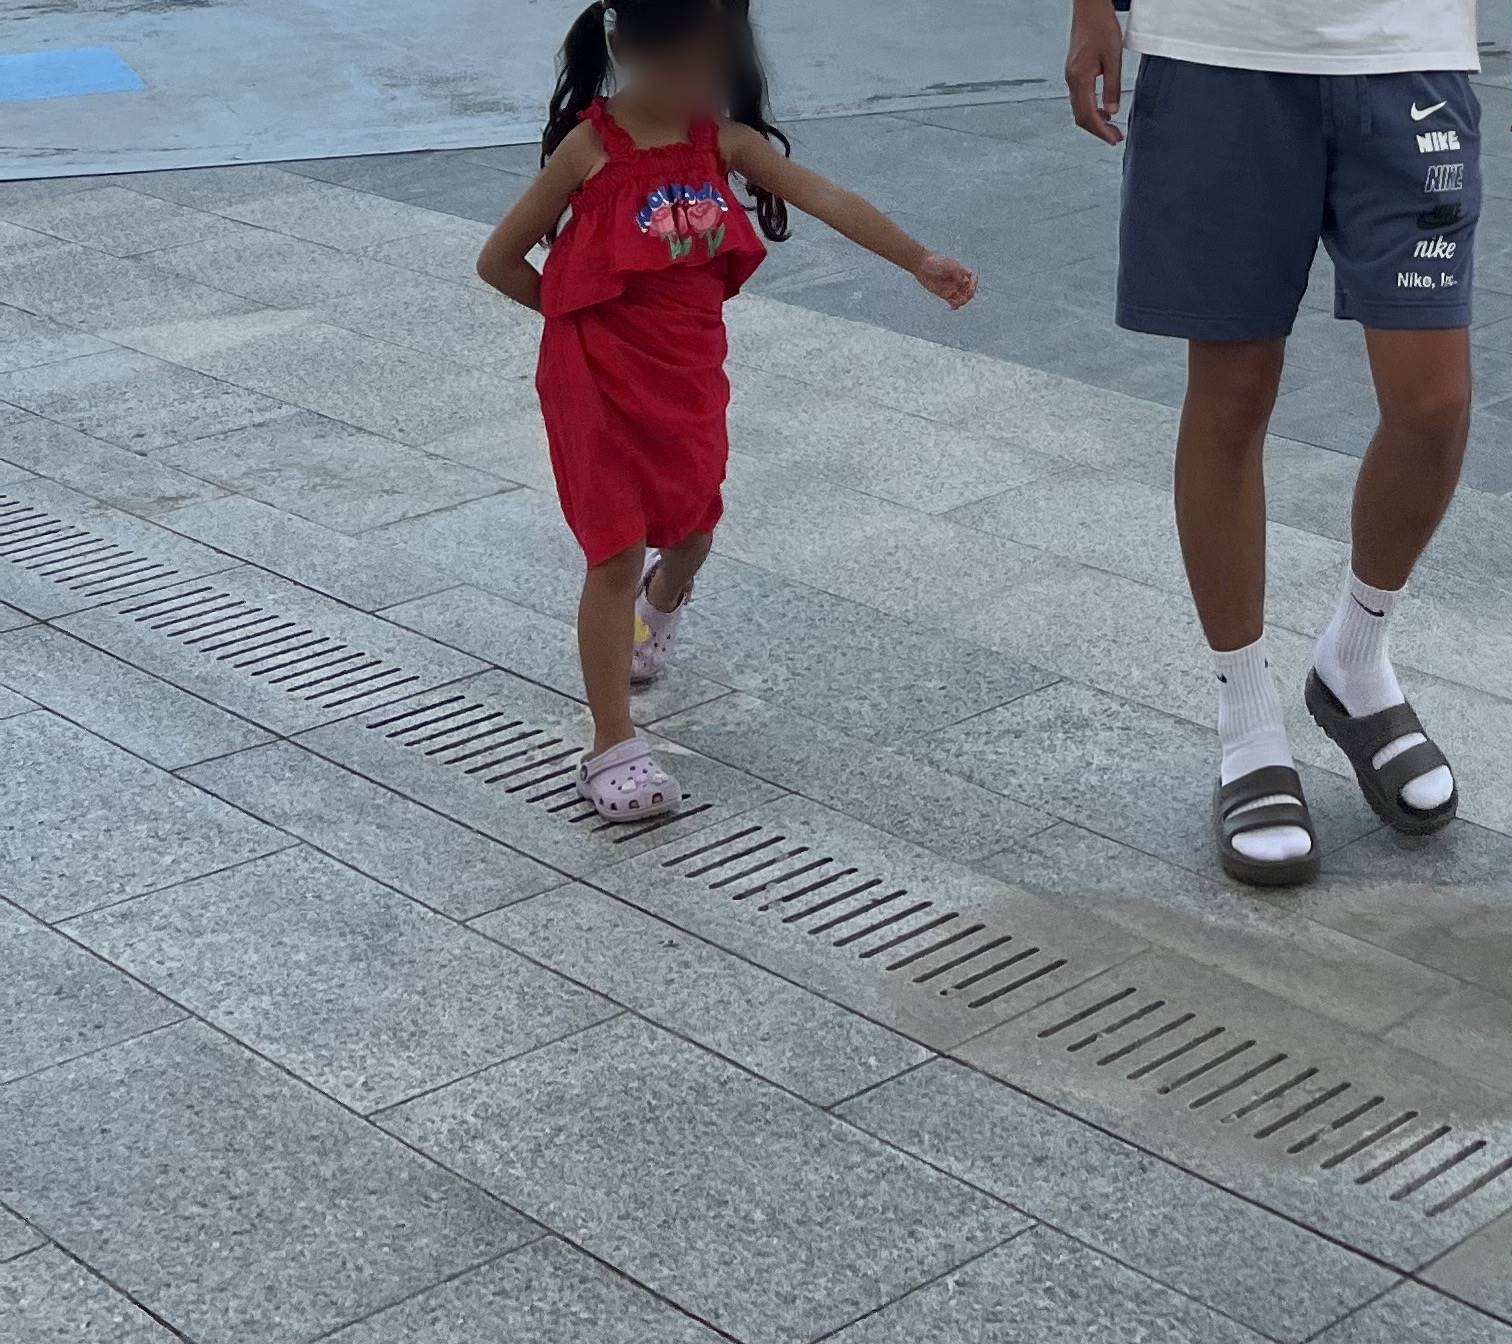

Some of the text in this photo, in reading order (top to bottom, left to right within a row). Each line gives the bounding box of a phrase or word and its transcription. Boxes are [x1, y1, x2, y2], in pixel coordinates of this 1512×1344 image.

[1415, 130, 1461, 153] NIKE
[1423, 163, 1464, 192] NIKE
[1413, 235, 1457, 259] nike
[1397, 271, 1436, 289] Nike,
